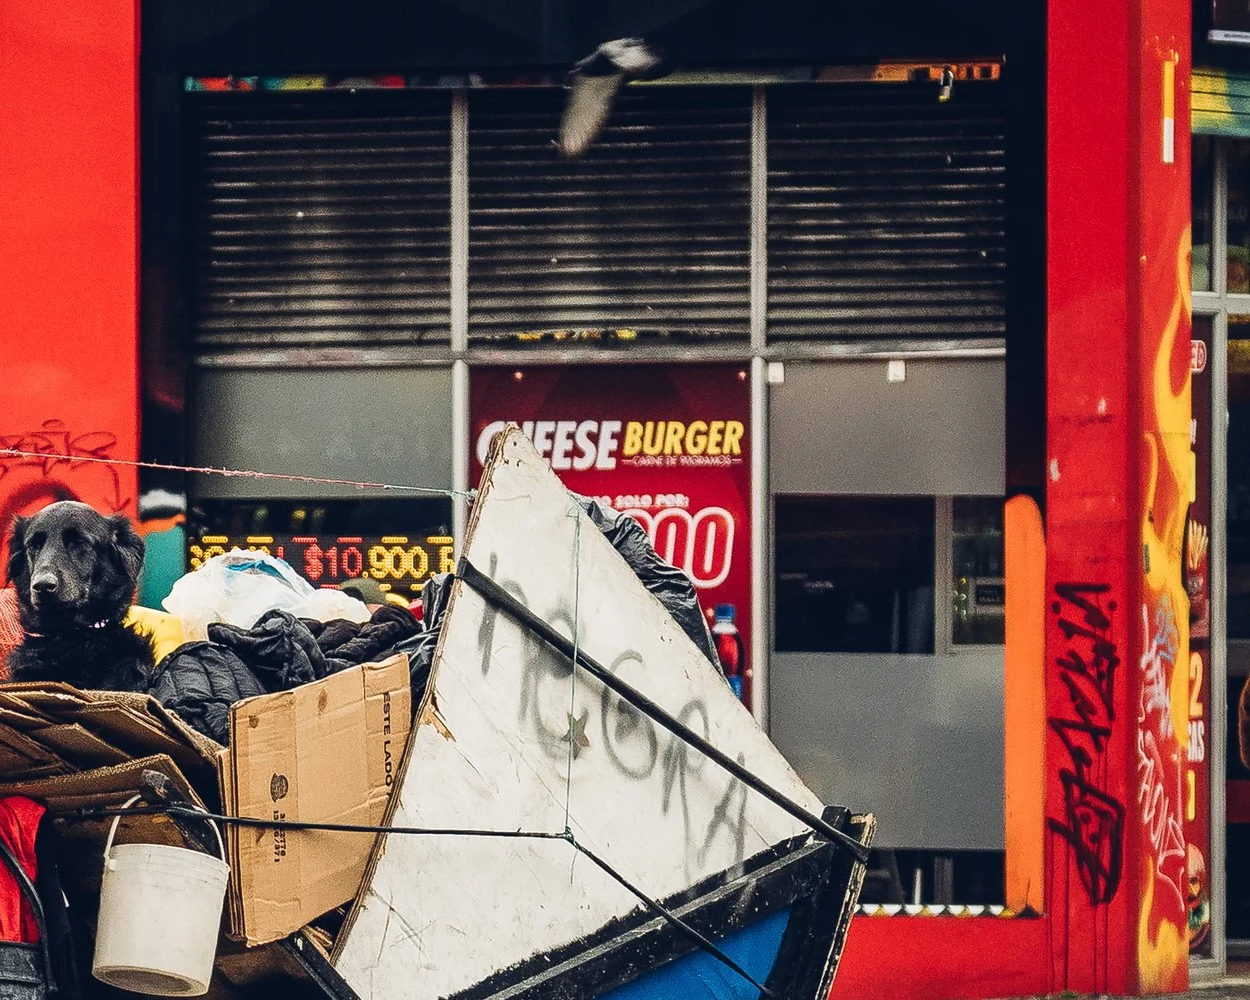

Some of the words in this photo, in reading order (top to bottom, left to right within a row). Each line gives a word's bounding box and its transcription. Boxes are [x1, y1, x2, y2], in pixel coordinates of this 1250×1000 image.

[623, 421, 745, 456] BURGER
[383, 691, 391, 735] ESTE
[383, 740, 393, 787] LADO
